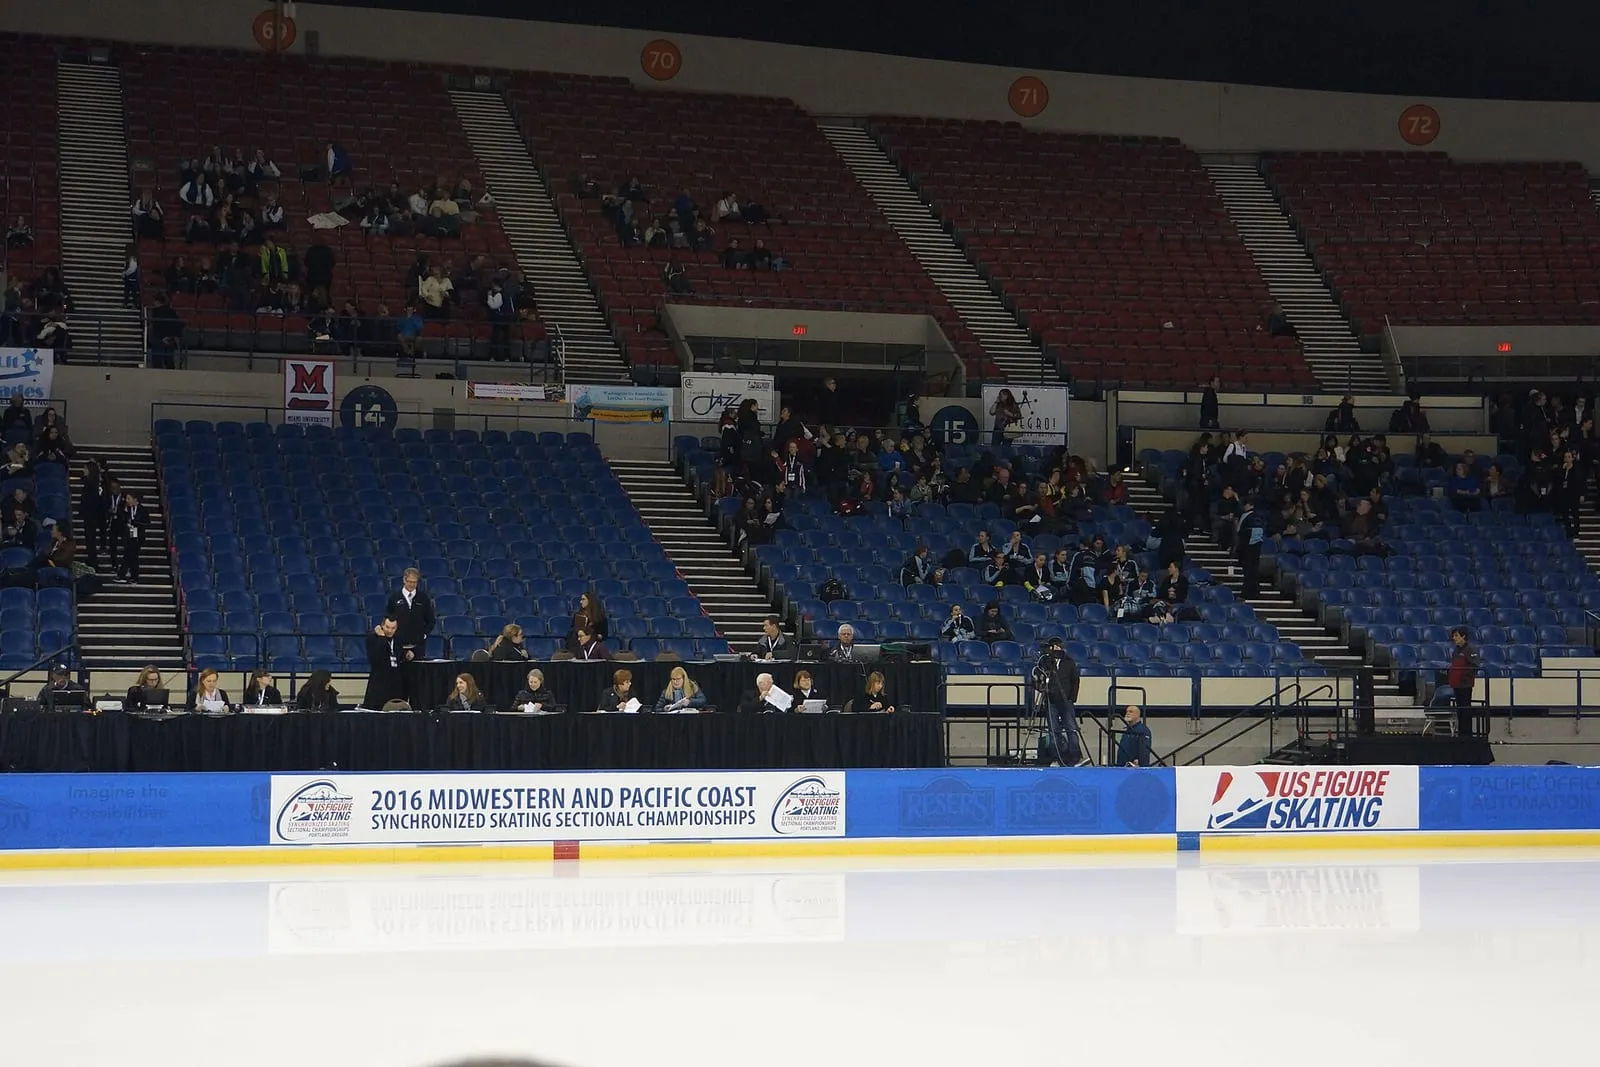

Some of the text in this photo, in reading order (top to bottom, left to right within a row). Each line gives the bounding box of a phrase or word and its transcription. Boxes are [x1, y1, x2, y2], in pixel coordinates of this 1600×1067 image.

[648, 51, 675, 69] 70
[1019, 88, 1038, 105] 71
[1407, 116, 1433, 134] 72
[289, 363, 329, 395] M
[355, 403, 386, 428] 14
[944, 420, 967, 444] 15
[1311, 770, 1390, 797] FIGURE
[1543, 775, 1600, 792] OFFIC
[370, 786, 757, 811] 2016 MIDWESTERN AND PACIFIC COAST
[311, 811, 352, 821] SKATING
[371, 810, 756, 830] SYNCHRONIZED SKATING SECTIONAL CHAMPIONSHIPS
[803, 806, 839, 816] SKATING
[1271, 797, 1383, 829] SKATING
